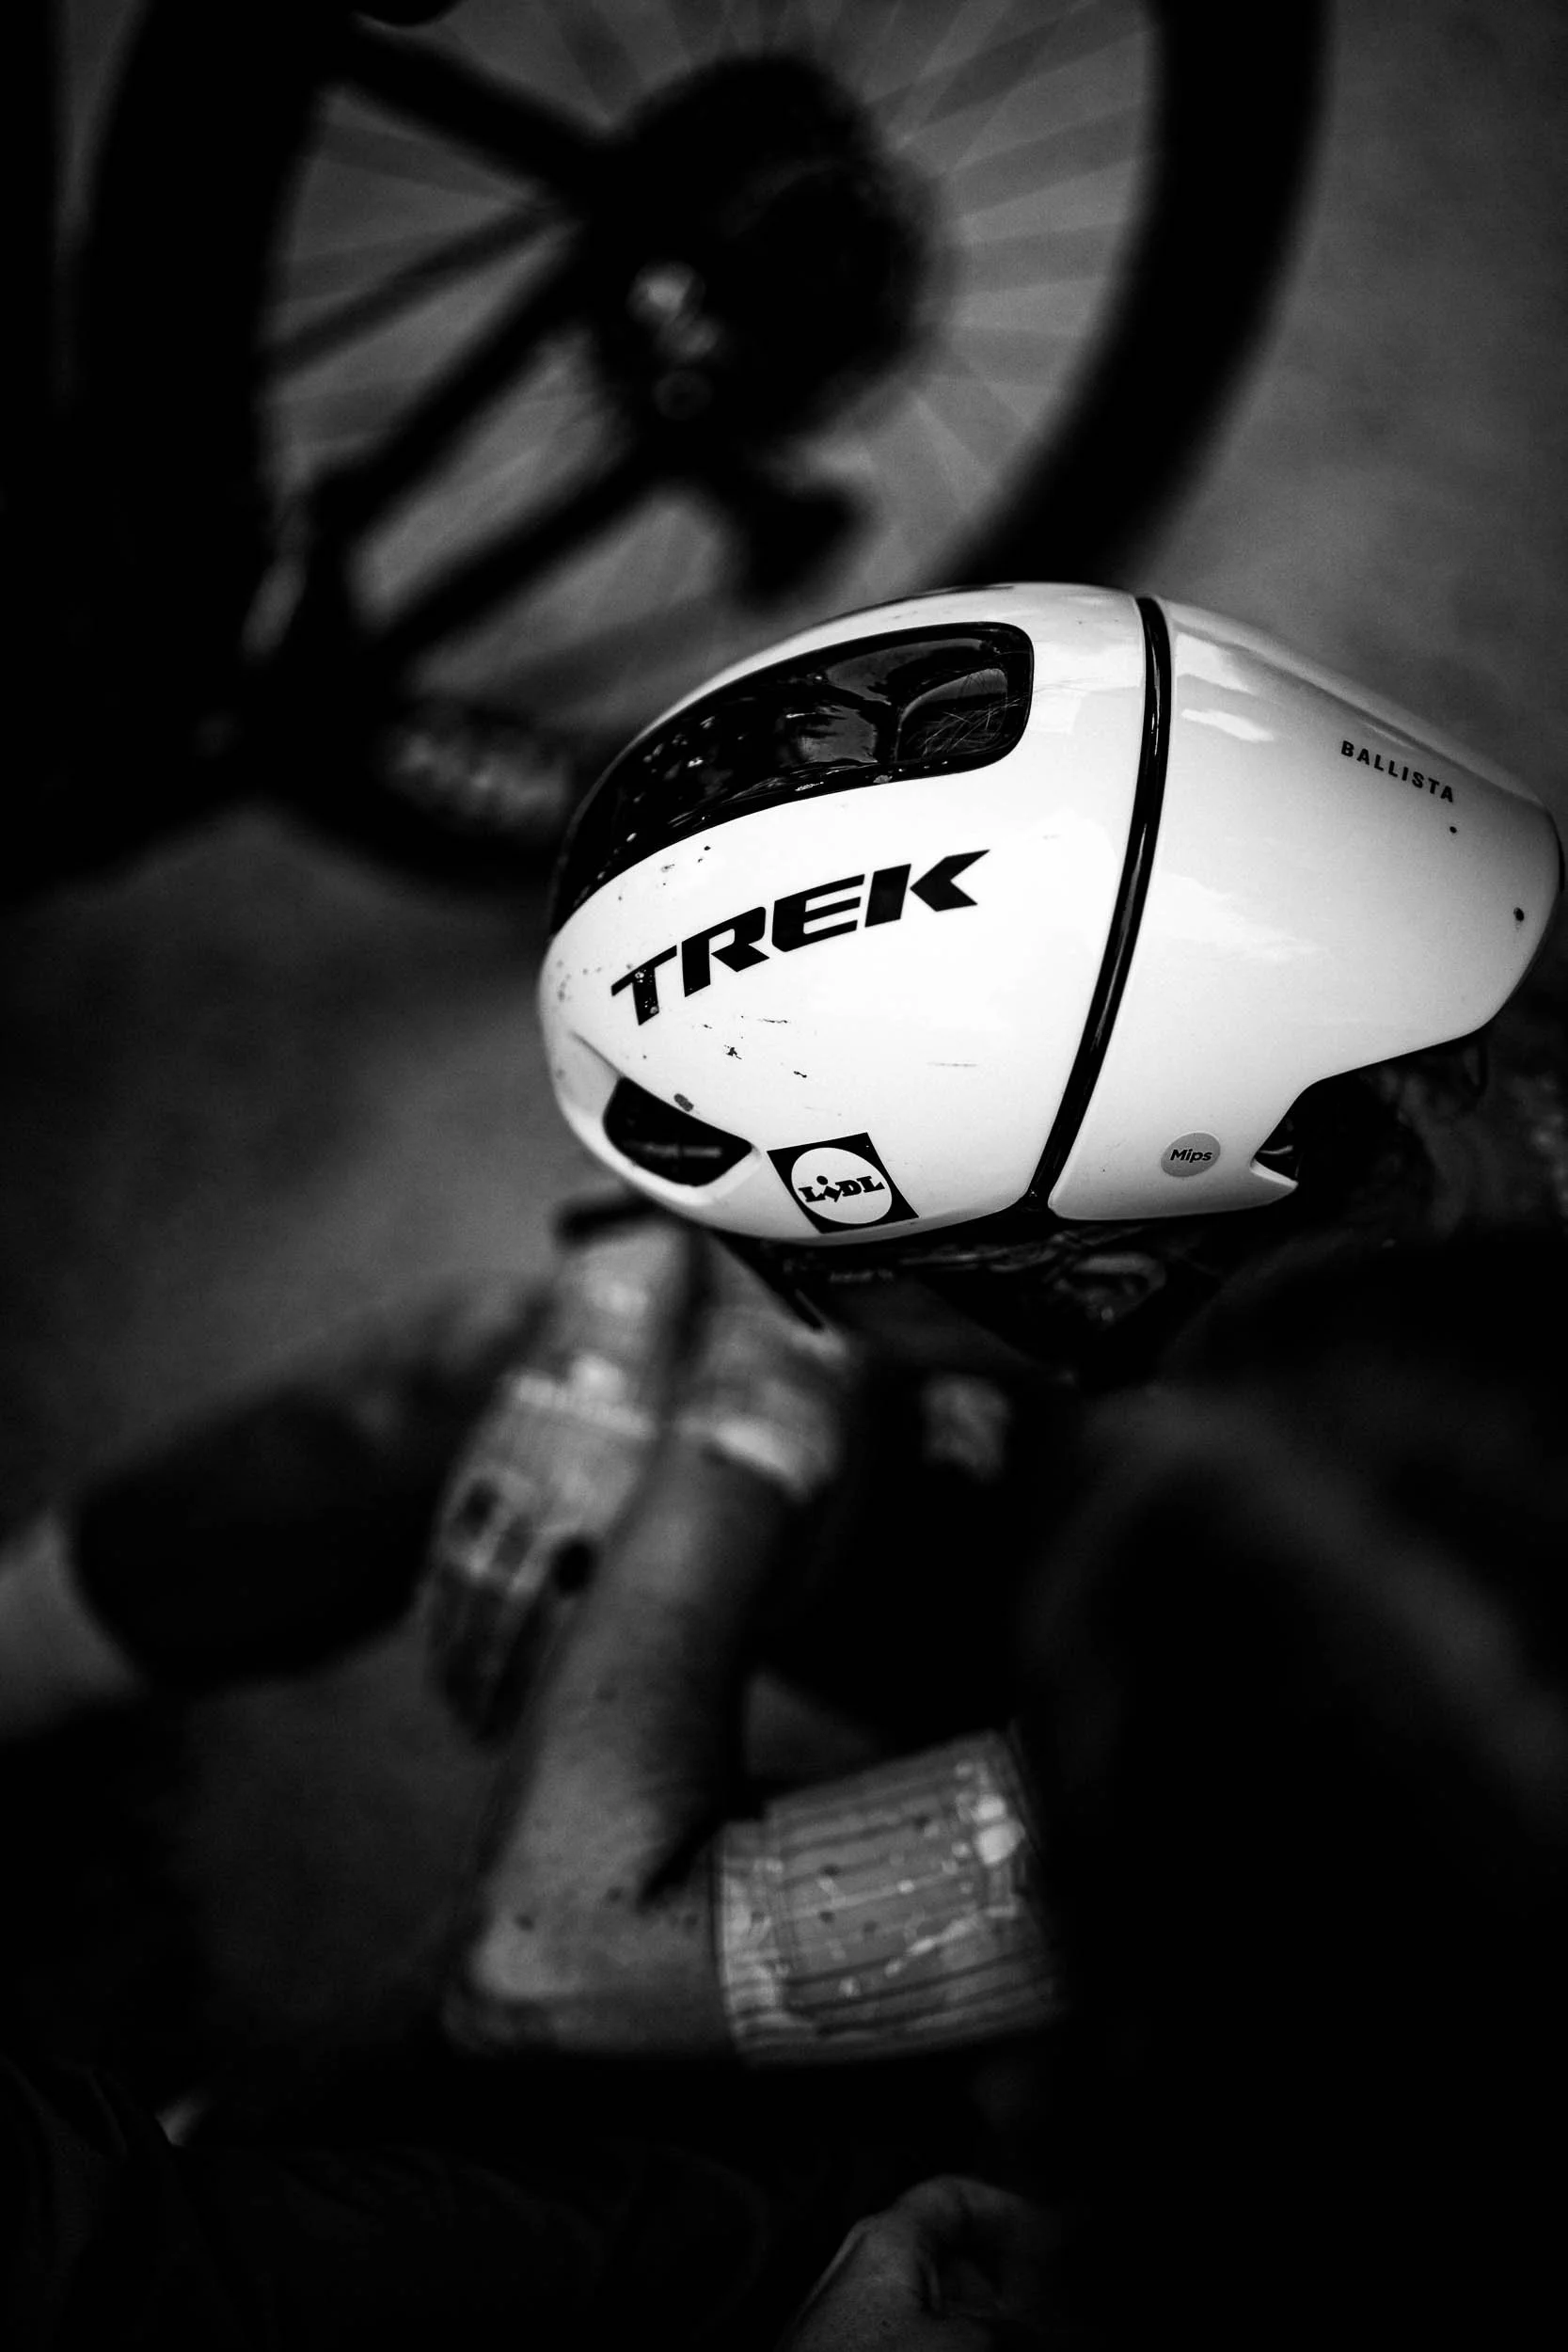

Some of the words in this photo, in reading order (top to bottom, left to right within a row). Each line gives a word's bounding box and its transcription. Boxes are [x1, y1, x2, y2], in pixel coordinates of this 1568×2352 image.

[1340, 740, 1454, 803] BALLISTA
[611, 850, 989, 1025] TREK
[1169, 1149, 1212, 1164] Mips
